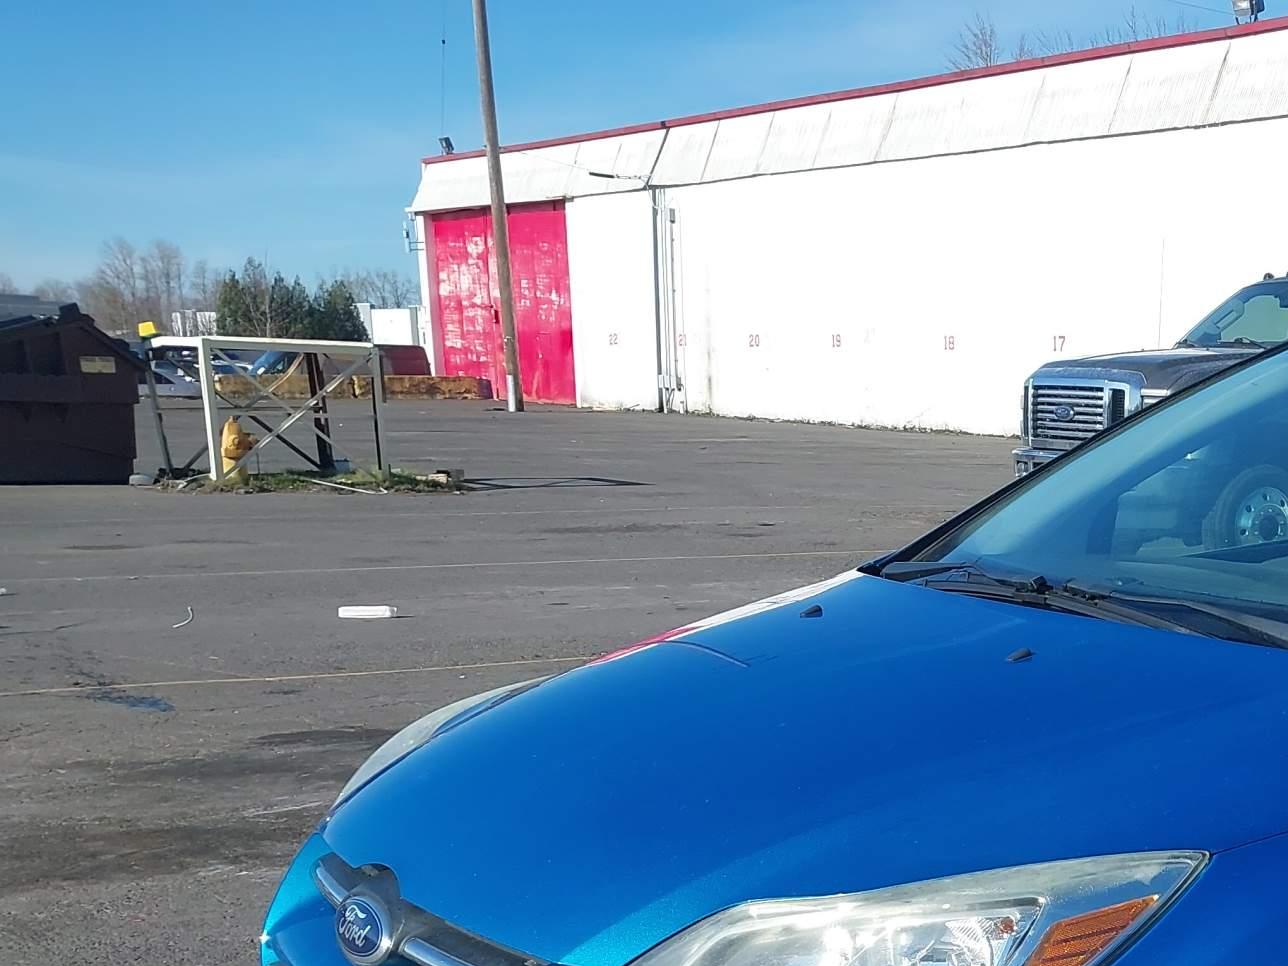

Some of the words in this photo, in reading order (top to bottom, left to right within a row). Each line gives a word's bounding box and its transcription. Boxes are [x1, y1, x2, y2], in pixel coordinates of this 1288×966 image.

[608, 333, 618, 345] 22
[748, 333, 760, 347] 20
[831, 333, 841, 347] 19
[944, 335, 955, 350] 18
[1053, 335, 1066, 352] 17
[339, 904, 371, 947] Ford
